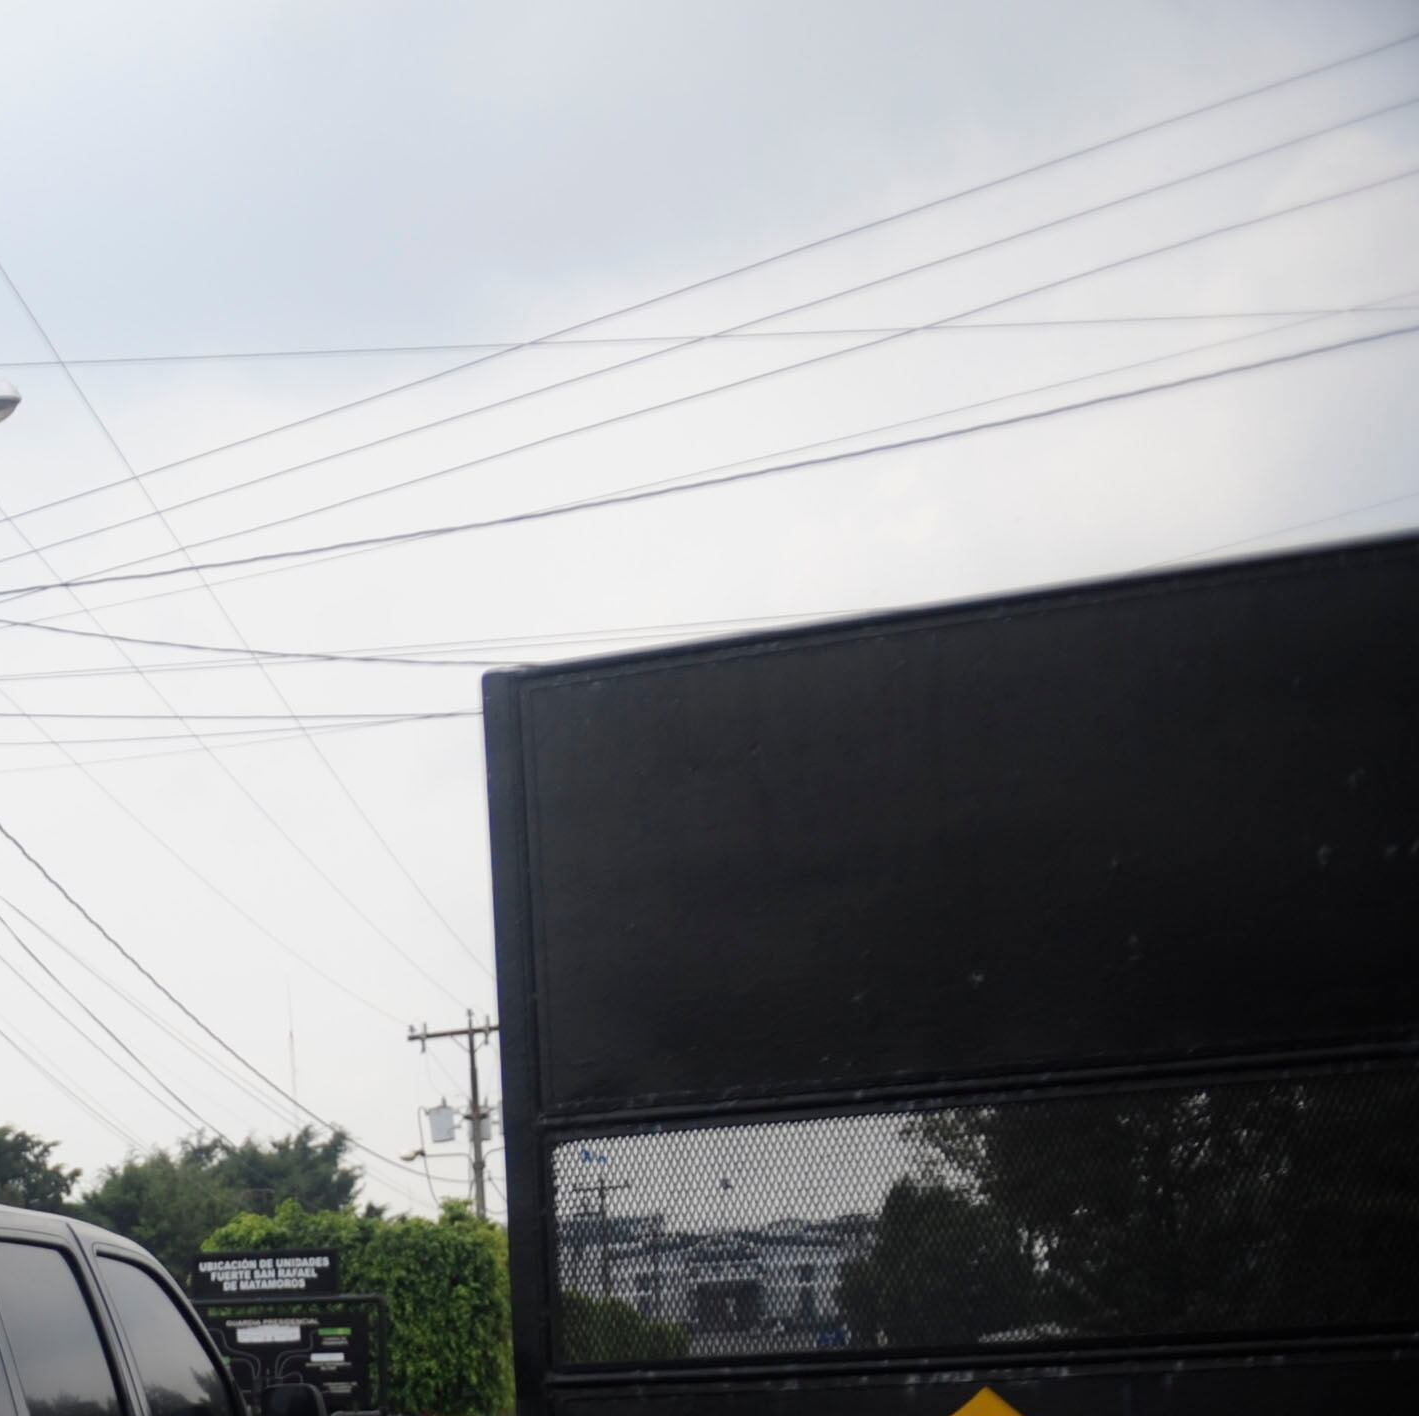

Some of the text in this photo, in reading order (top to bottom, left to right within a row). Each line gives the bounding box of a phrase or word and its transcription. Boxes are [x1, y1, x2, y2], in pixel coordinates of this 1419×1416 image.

[198, 1256, 330, 1272] UBICACIÓN DE UNIDADES
[210, 1267, 318, 1282] FUERTE SAN RAFAEL
[223, 1278, 306, 1292] DE MATAMOROS
